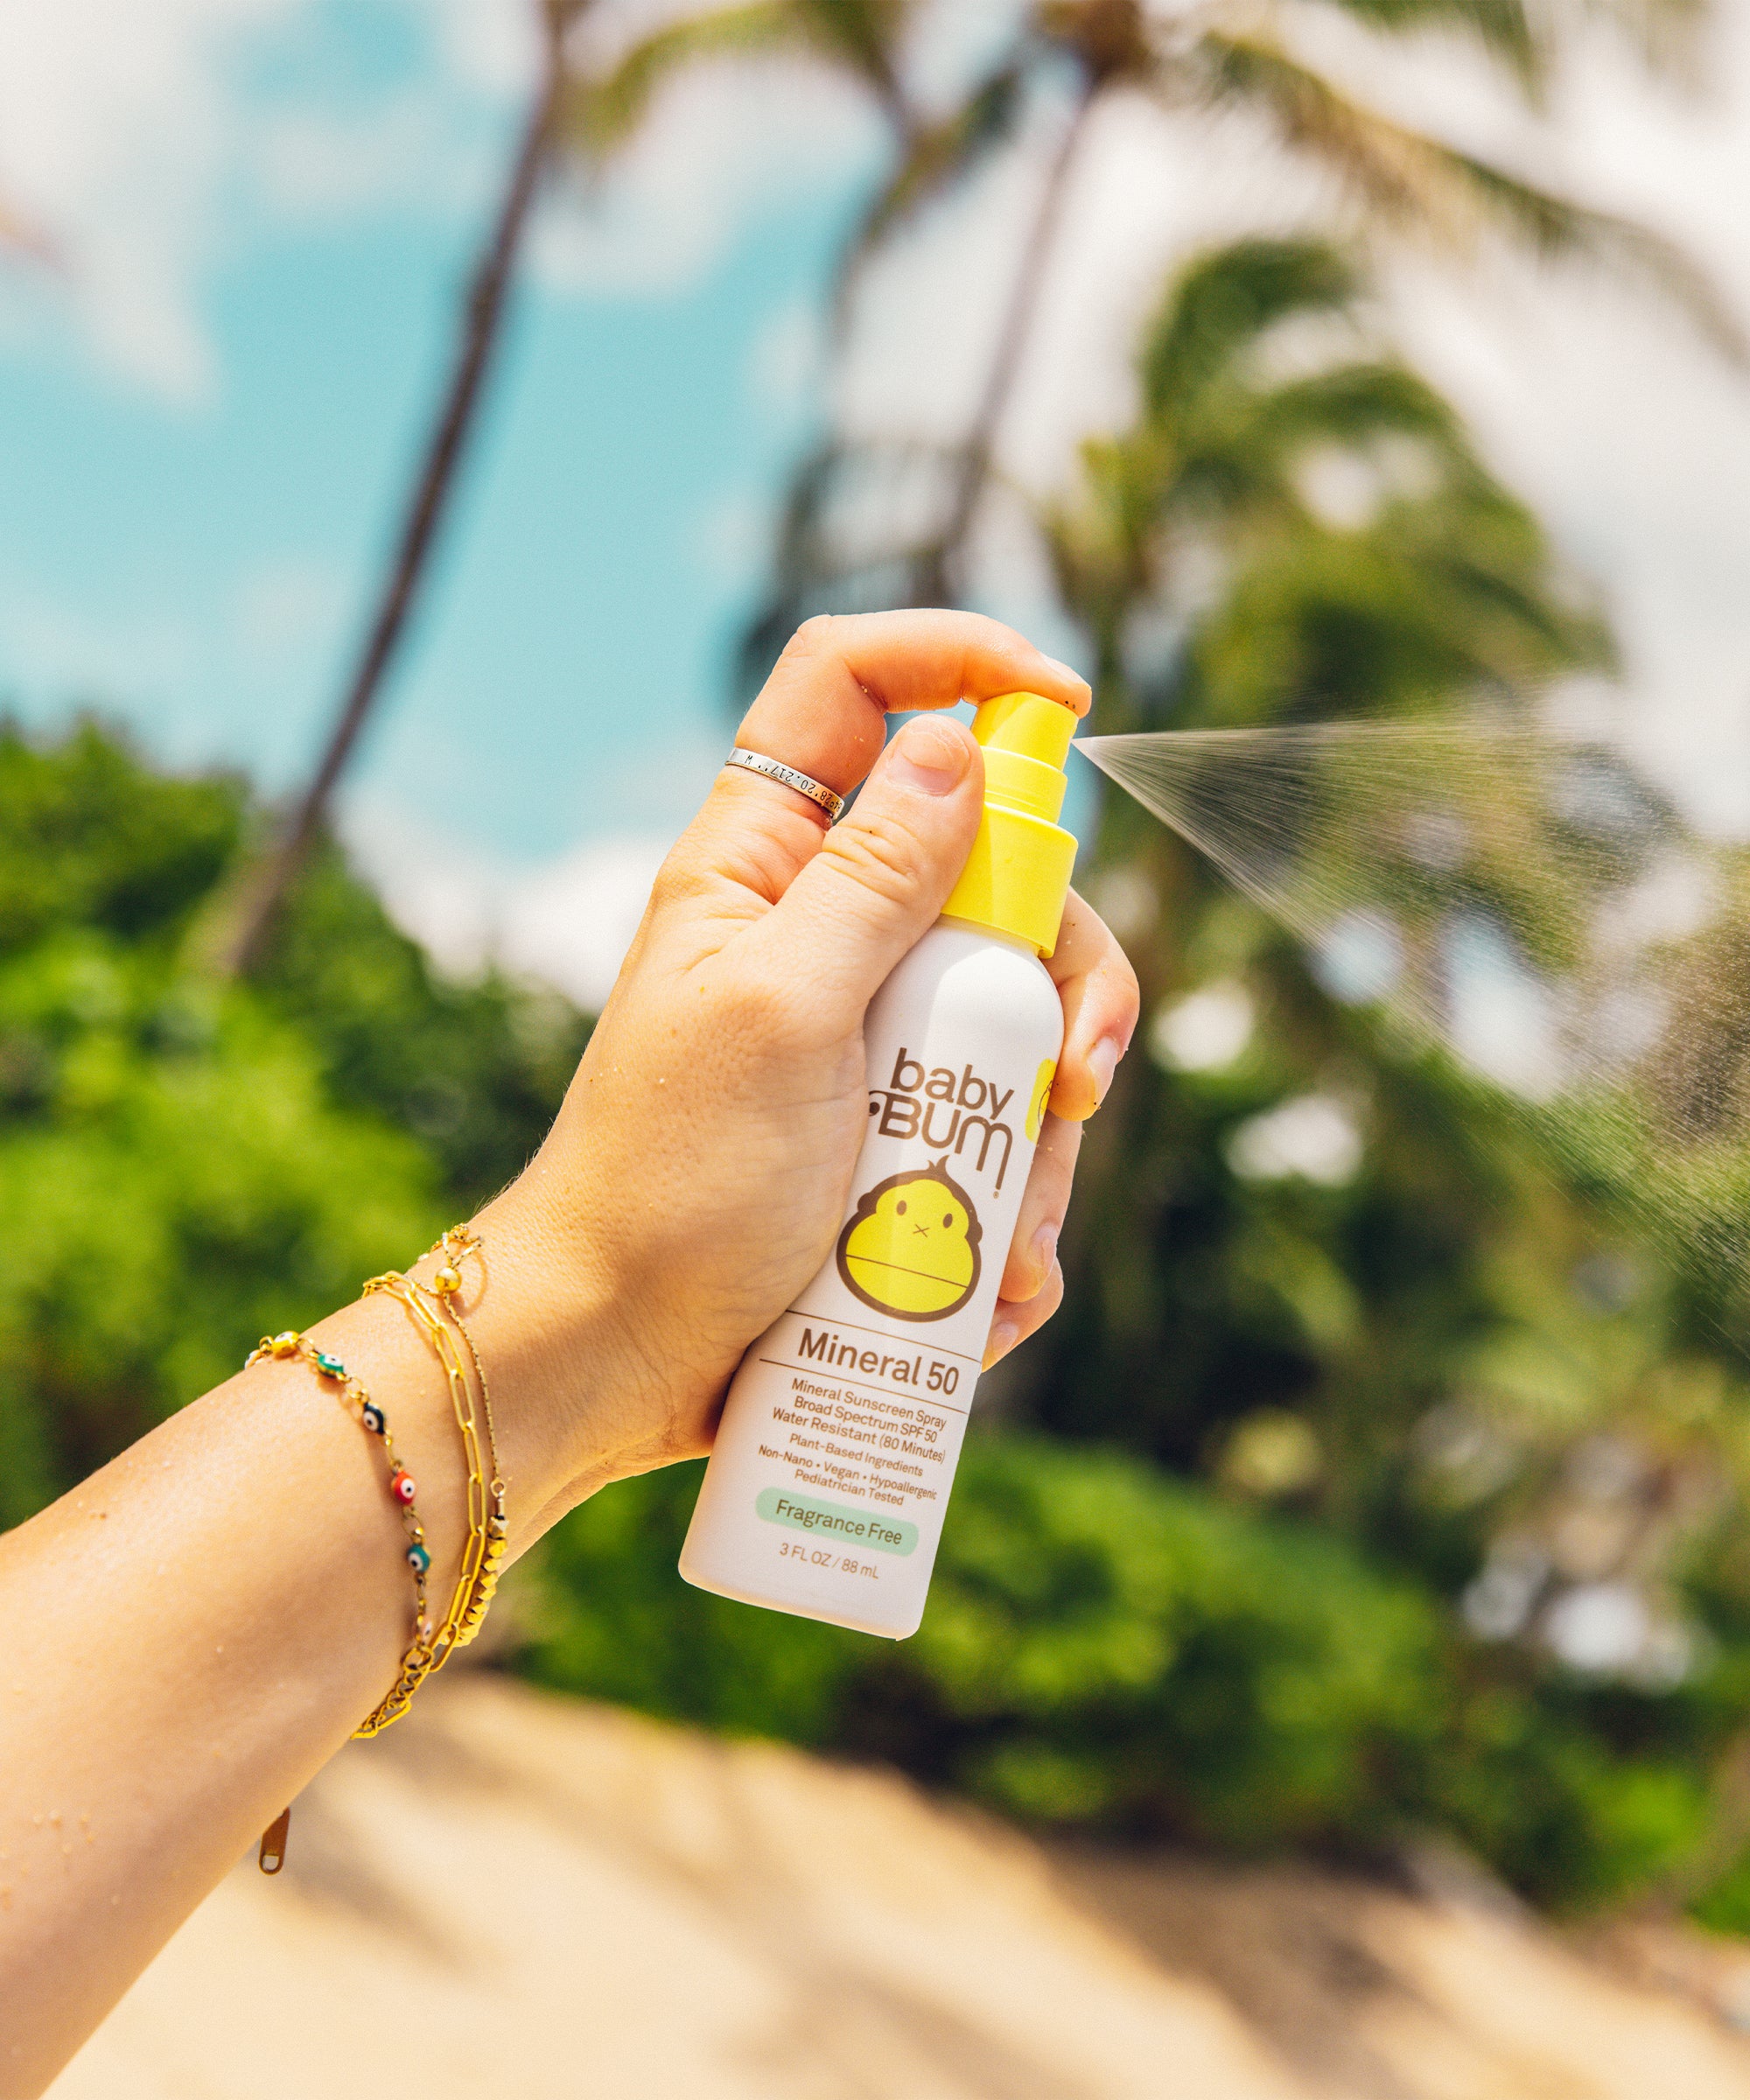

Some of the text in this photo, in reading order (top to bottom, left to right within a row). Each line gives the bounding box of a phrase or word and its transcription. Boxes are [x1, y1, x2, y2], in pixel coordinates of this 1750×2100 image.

[744, 754, 753, 765] W
[890, 1046, 1015, 1120] baby
[798, 1327, 960, 1396] Mineral 50
[791, 1377, 947, 1432] Mineral Sunscreen Spray
[794, 1395, 937, 1444] Broad Spectrum SPF 50
[773, 1406, 946, 1465] Water Resistant (80 Minutes)
[789, 1432, 924, 1477] Plant-Based Ingredients
[758, 1444, 938, 1501] Non-Nano Vegan Hypoallergenic
[794, 1468, 905, 1506] Pediatrician Tested
[776, 1498, 903, 1544] Fragrance Free
[779, 1543, 789, 1556] 3
[791, 1545, 808, 1562] FL
[811, 1550, 832, 1567] OZ
[841, 1558, 859, 1573] 88
[860, 1565, 879, 1579] mL
